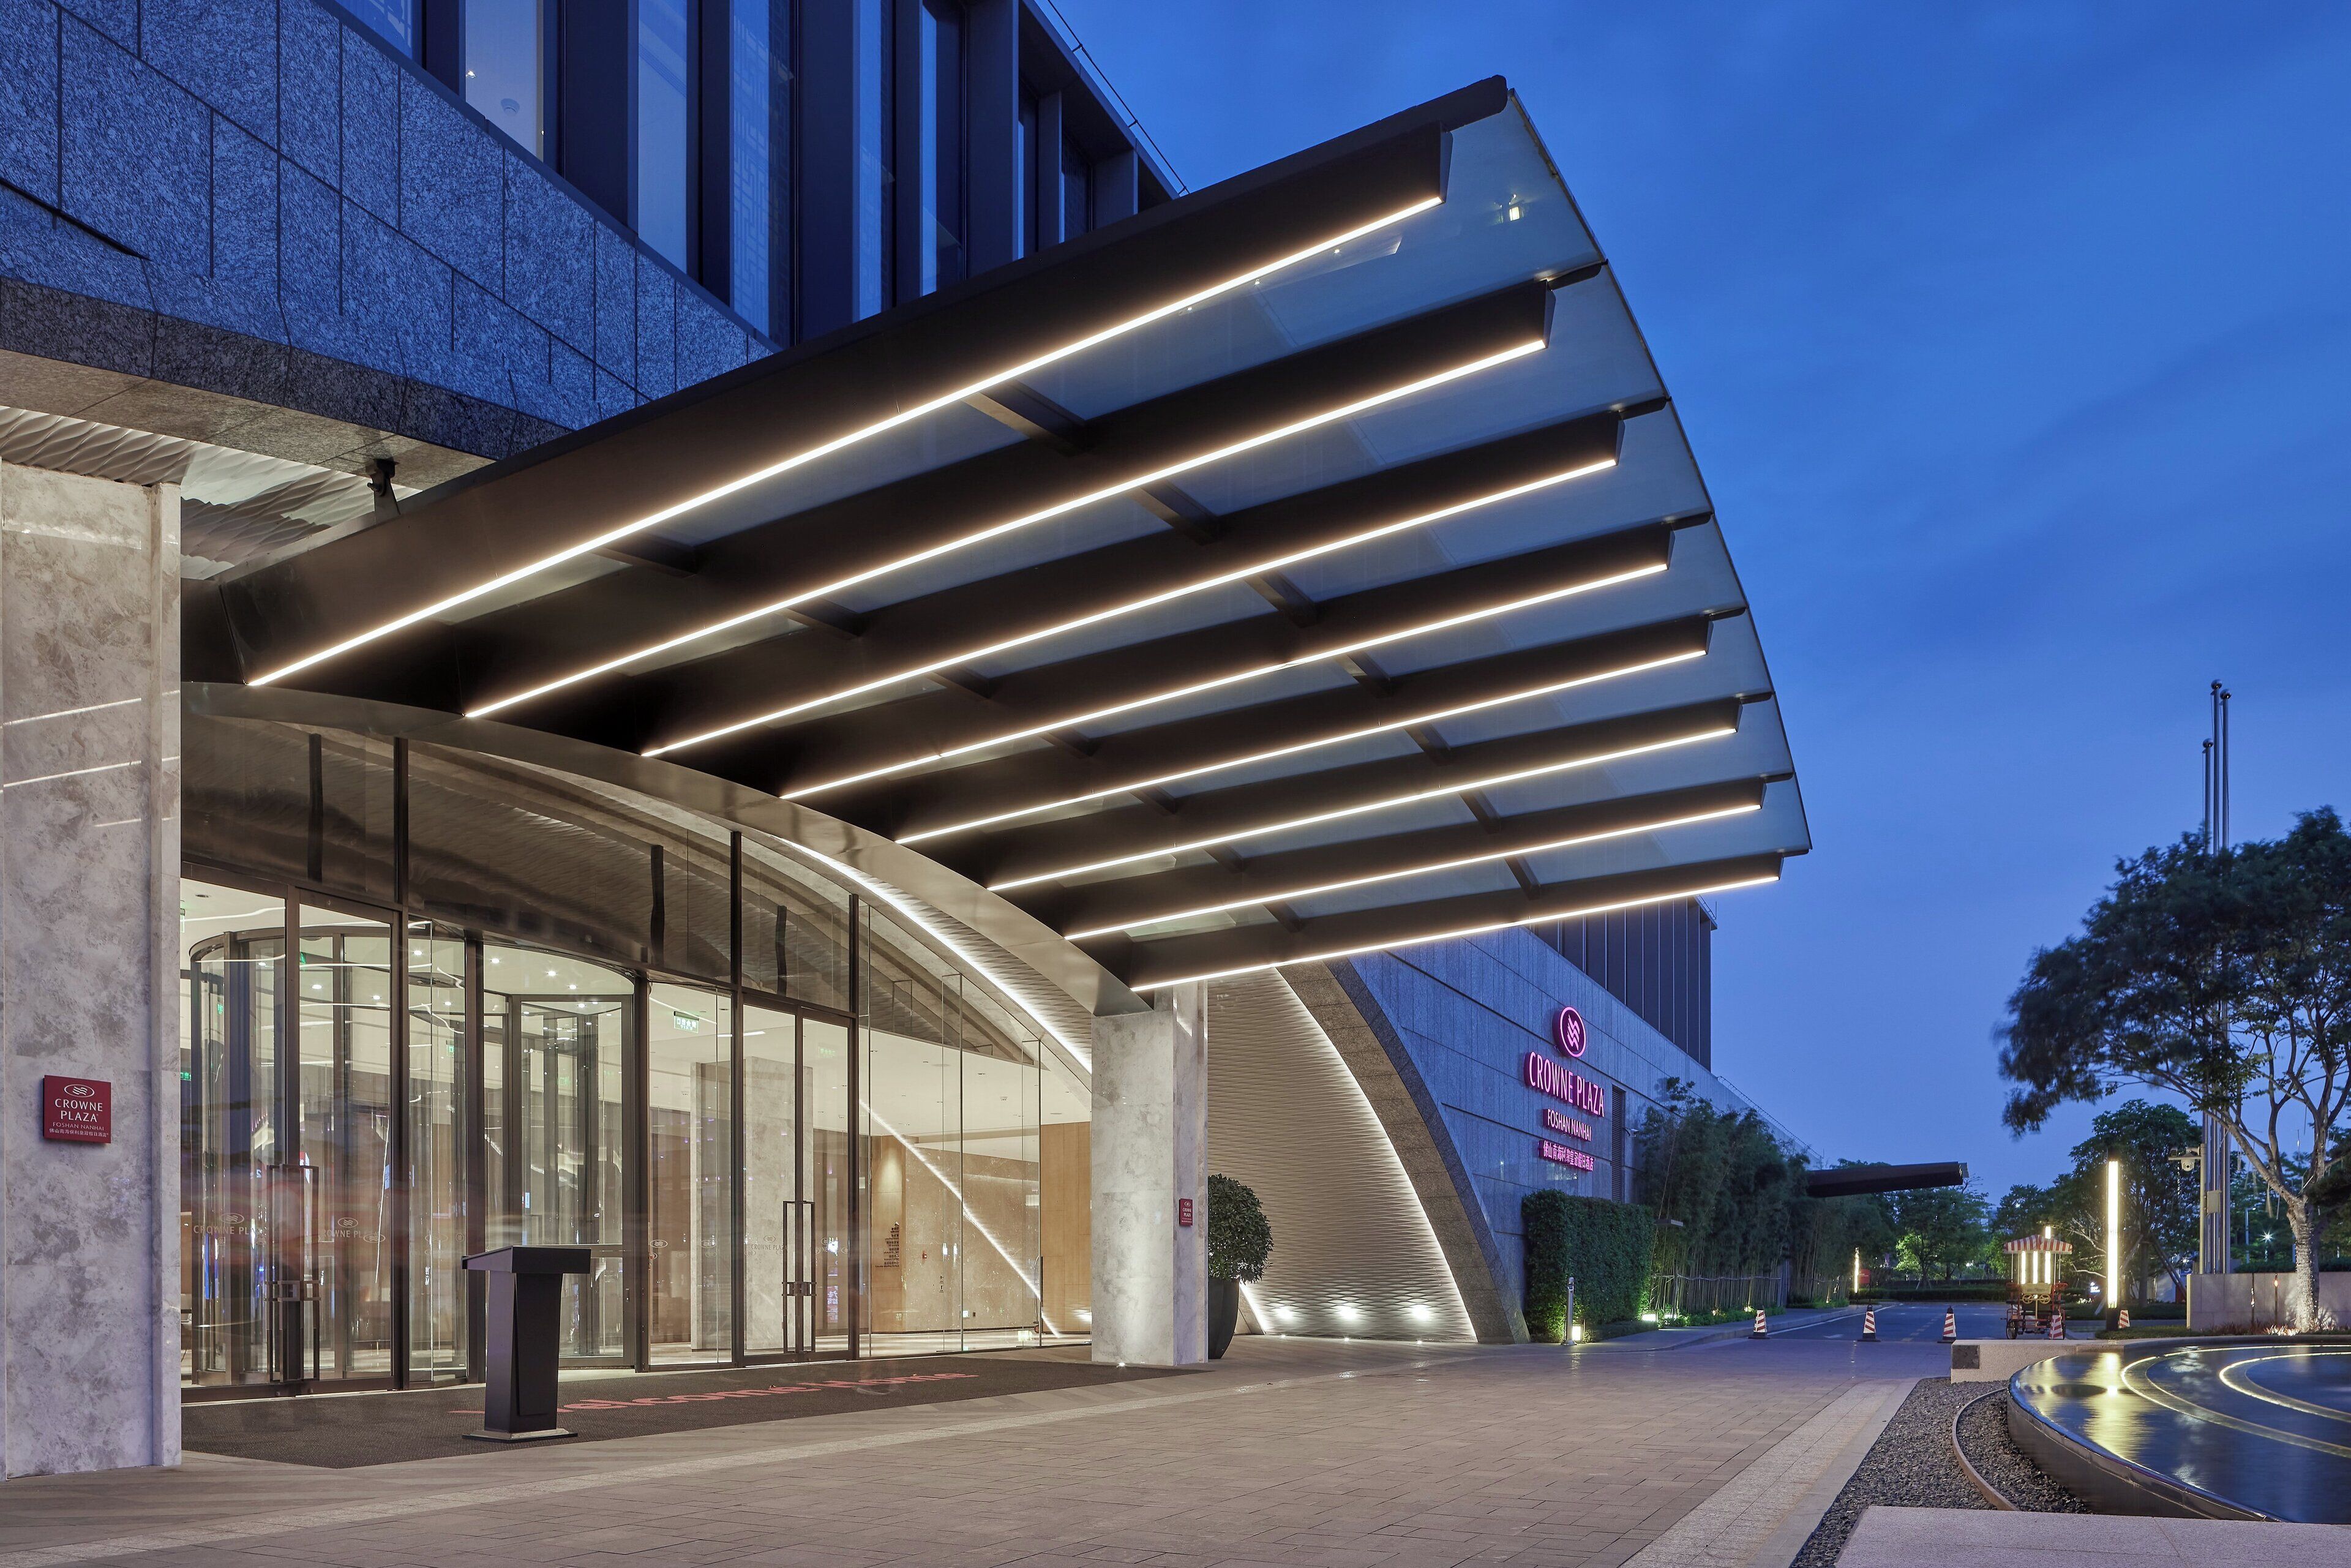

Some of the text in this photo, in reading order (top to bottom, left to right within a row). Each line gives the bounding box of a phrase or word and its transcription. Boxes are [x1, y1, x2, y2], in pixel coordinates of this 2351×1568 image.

[1529, 1051, 1604, 1117] CROWNE PLAZA
[54, 1098, 103, 1111] CROWNE
[61, 1110, 97, 1122] PLAZA
[1547, 1108, 1591, 1141] FOSHAN NANHAI
[193, 1225, 234, 1235] CROWNE
